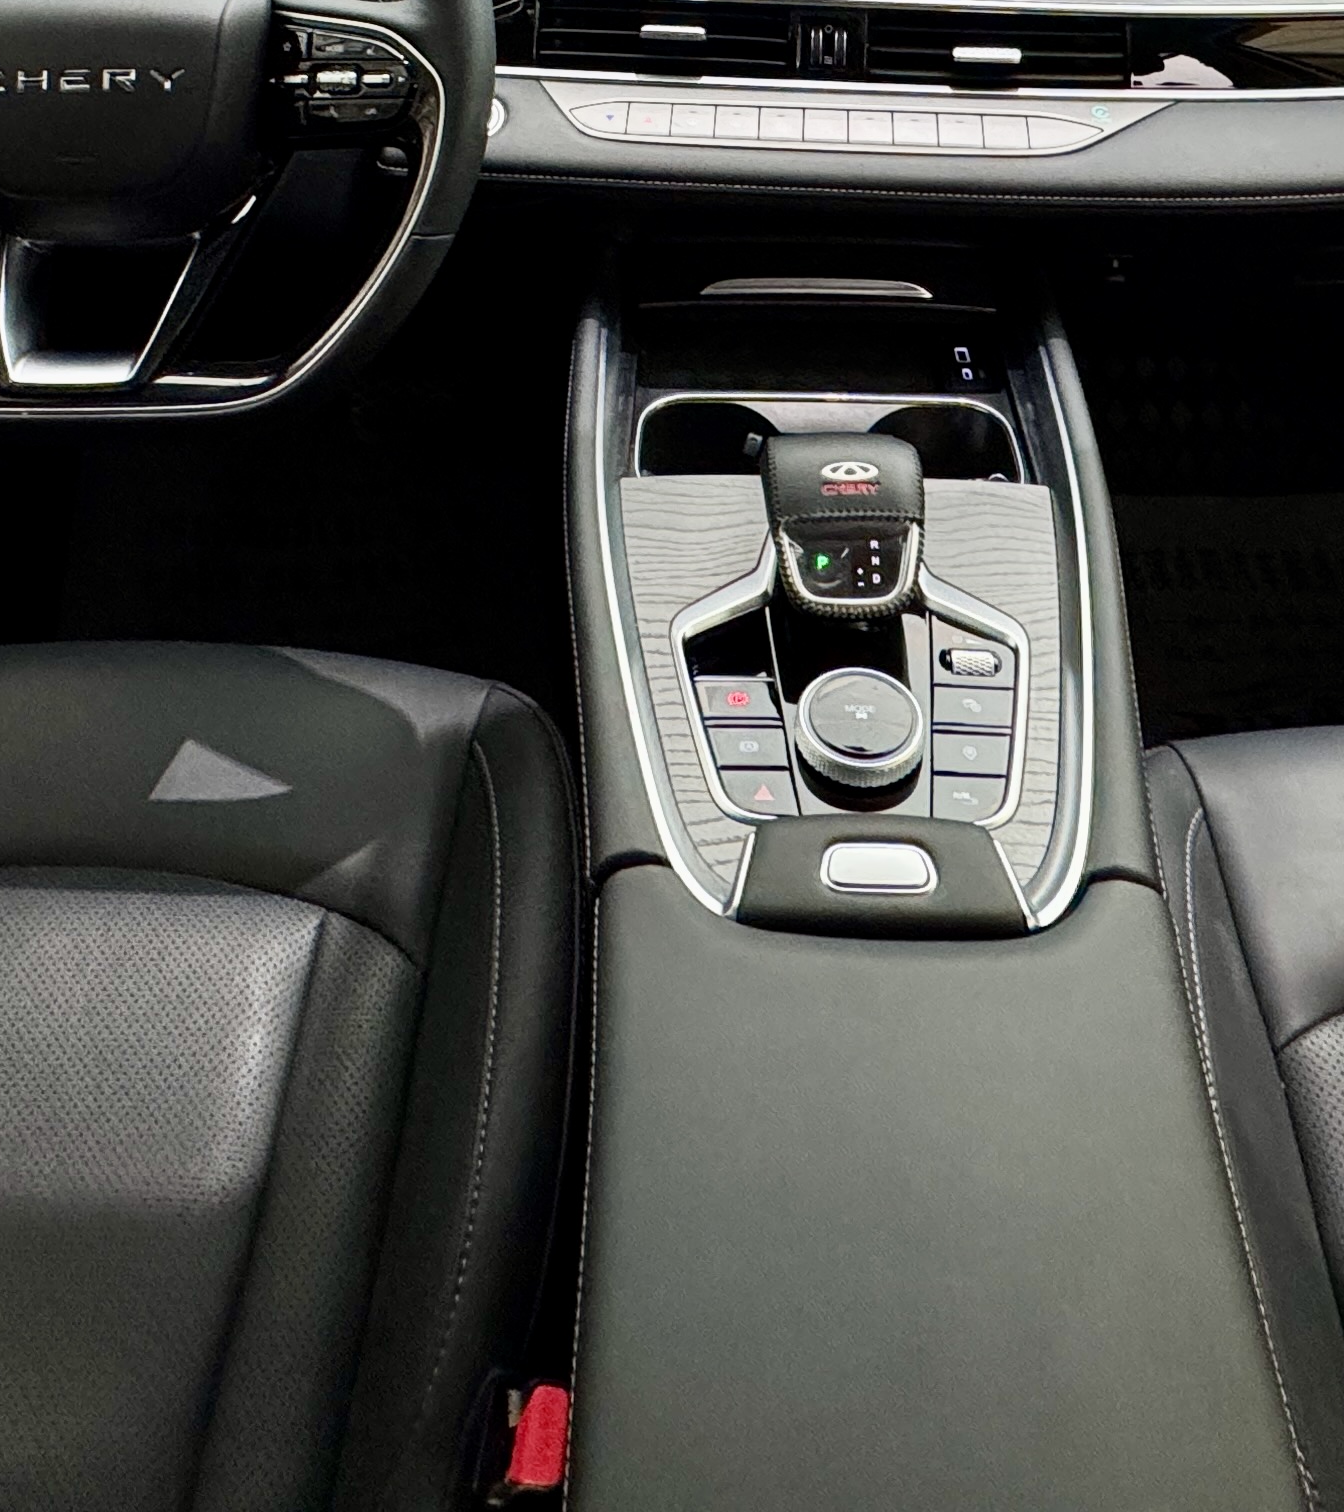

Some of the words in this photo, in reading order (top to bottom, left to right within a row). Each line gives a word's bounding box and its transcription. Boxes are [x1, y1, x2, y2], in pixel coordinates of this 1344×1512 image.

[869, 539, 881, 551] R
[816, 554, 830, 571] P
[872, 572, 882, 585] D
